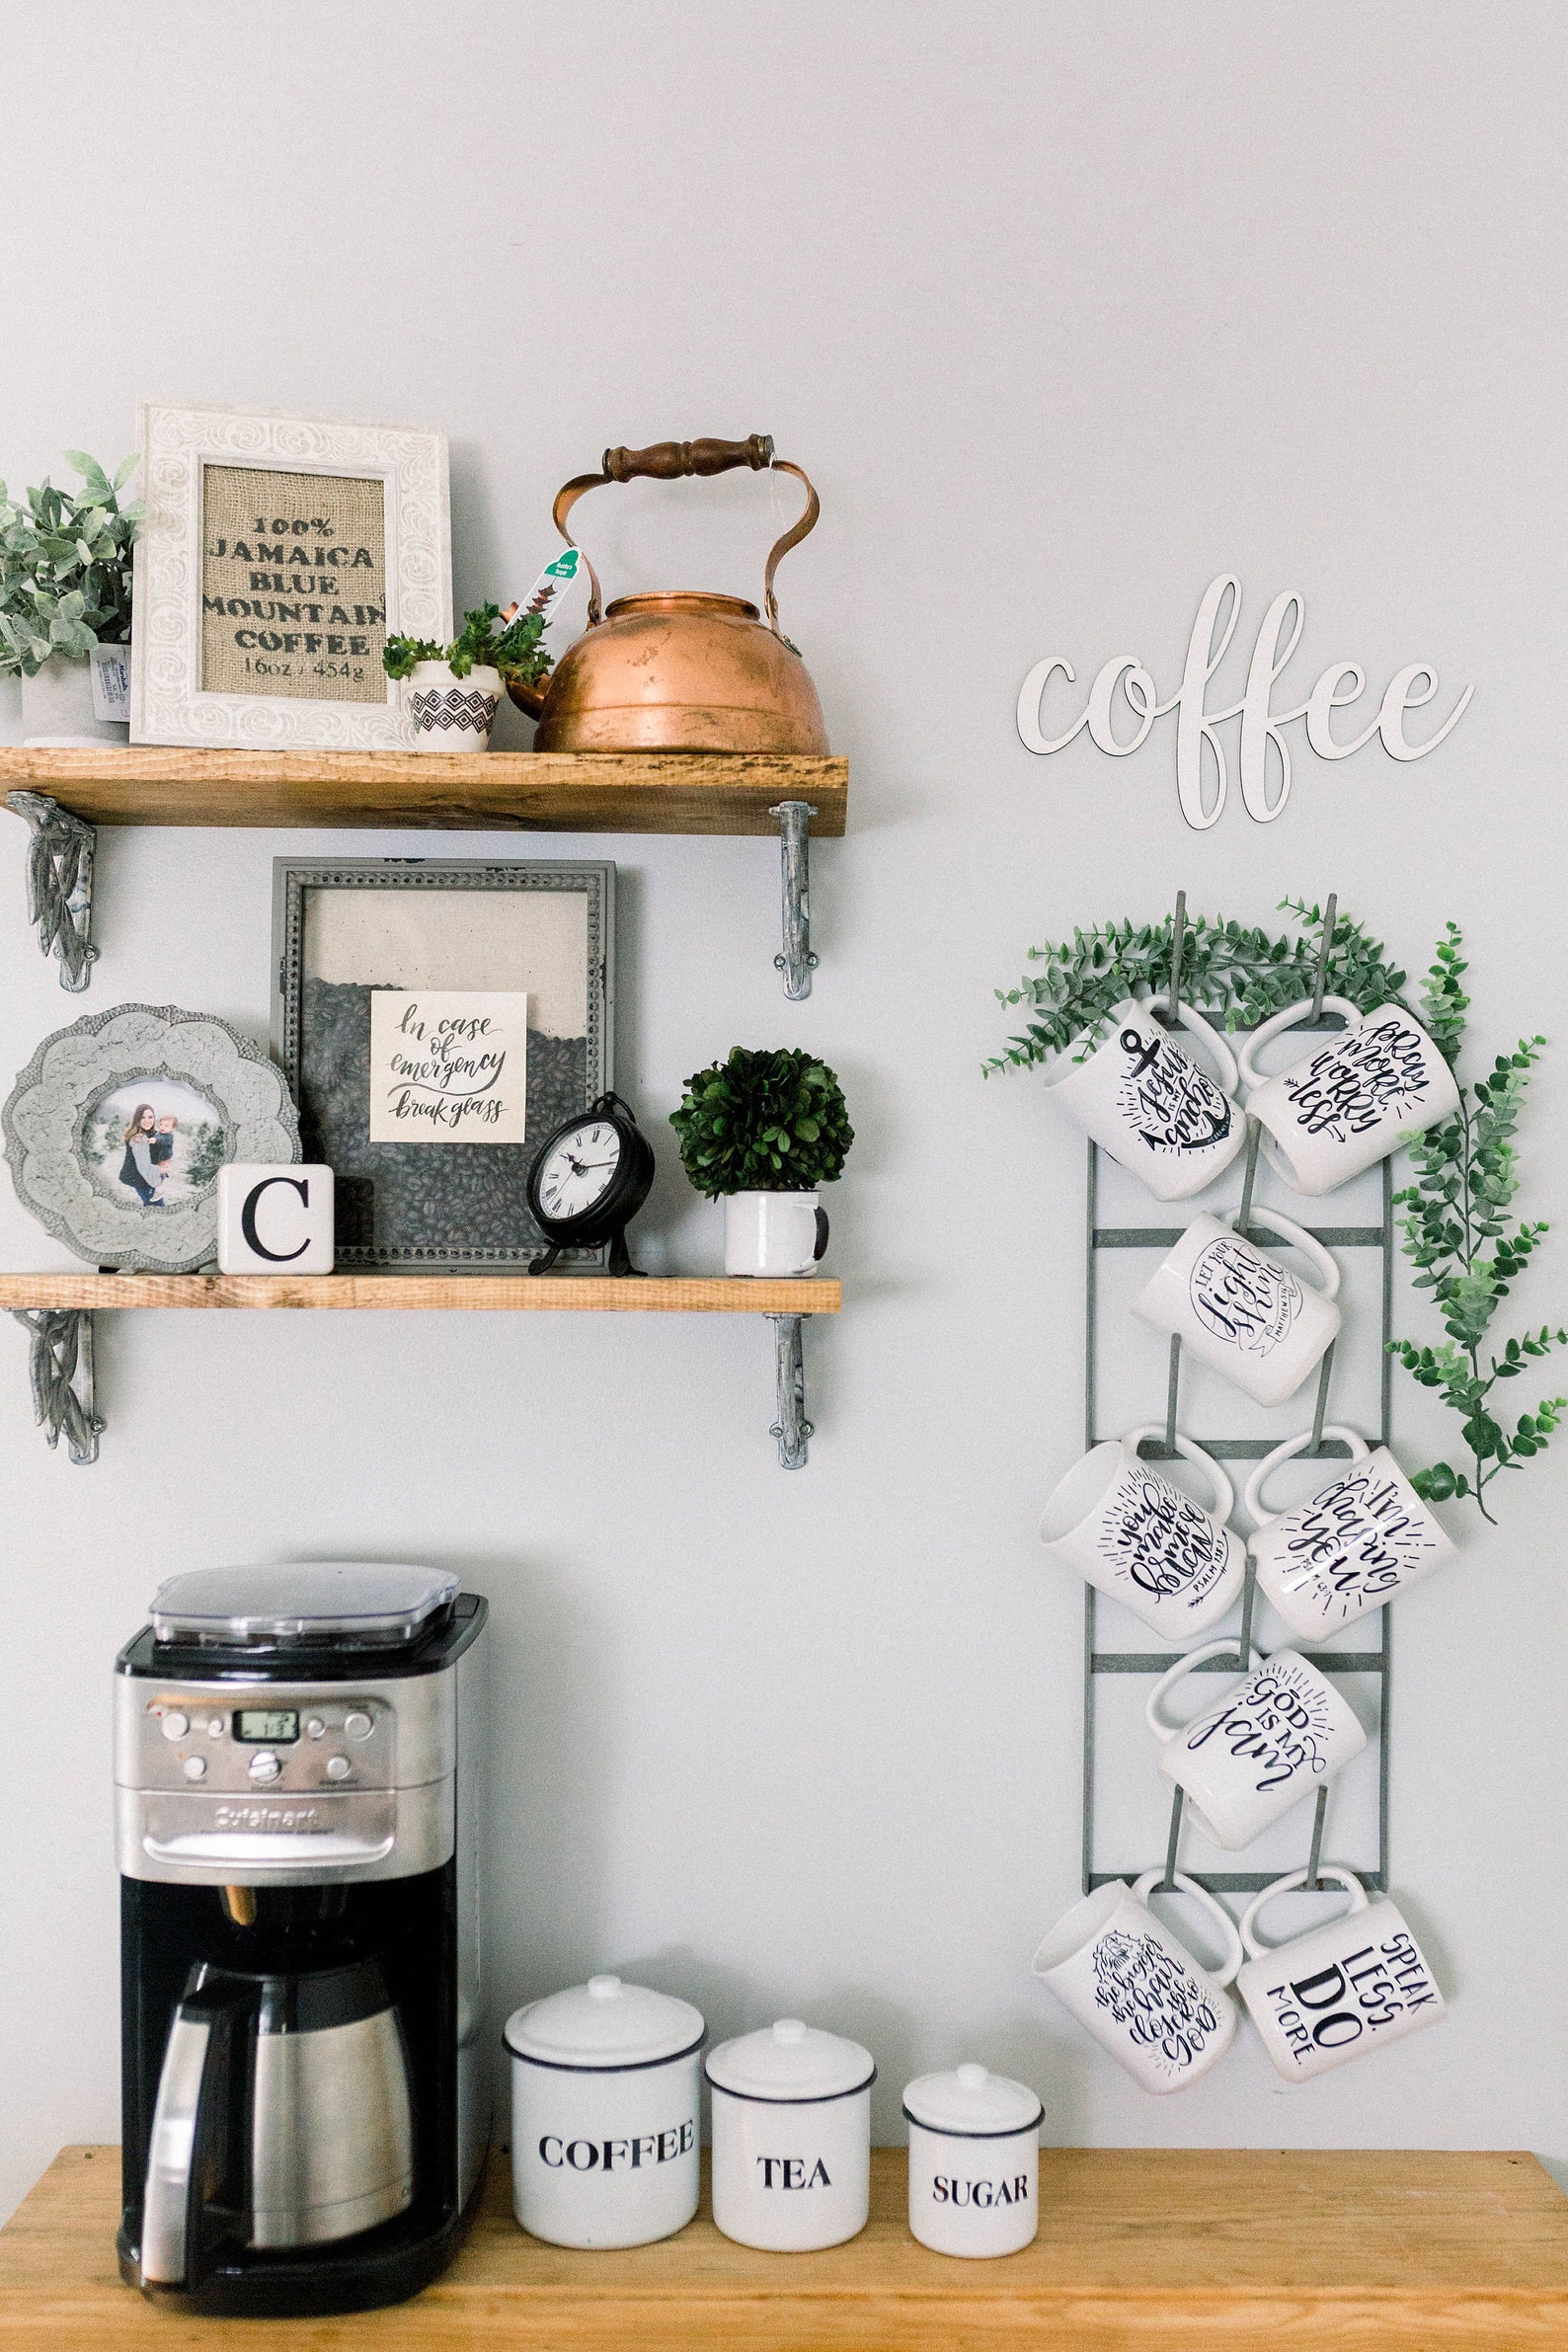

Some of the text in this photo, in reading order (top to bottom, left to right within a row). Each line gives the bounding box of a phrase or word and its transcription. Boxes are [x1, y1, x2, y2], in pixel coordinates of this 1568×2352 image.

[253, 517, 335, 536] 100%
[209, 539, 373, 568] JAMAICA
[250, 572, 340, 594] BLUE
[202, 594, 386, 625] MOUNTAIN
[234, 629, 369, 656] COFFEE
[246, 657, 291, 675] 16oz
[314, 661, 364, 682] 454g
[1016, 572, 1476, 830] coffee
[395, 1003, 504, 1041] In case
[430, 1033, 462, 1062] of
[386, 1051, 507, 1096] emergency
[1137, 1047, 1188, 1123] Jesus
[388, 1090, 510, 1128] break glass
[1167, 1089, 1182, 1112] IS MY
[1289, 1077, 1342, 1138] less
[241, 1177, 311, 1262] C
[1195, 1240, 1232, 1288] LET YOUR
[1232, 1264, 1288, 1350] shine
[1275, 1302, 1289, 1337] MATTHEW
[1117, 1503, 1153, 1546] you
[1133, 1483, 1177, 1561] make
[1364, 1481, 1409, 1537] I'm
[1164, 1521, 1190, 1559] me
[1288, 1513, 1361, 1597] you.
[1312, 1478, 1401, 1593] chasing
[1193, 1565, 1217, 1592] PSALM
[1246, 1678, 1309, 1729] GOD
[1187, 1701, 1294, 1791] jam
[1255, 1707, 1326, 1773] IS MY
[1094, 1933, 1163, 2008] the bigger
[1112, 1953, 1185, 2024] the hair
[1187, 1977, 1199, 2000] to
[1341, 1946, 1404, 2031] LESS.
[1380, 1933, 1438, 2014] SPEAK
[1166, 1979, 1186, 2013] the
[1290, 1963, 1363, 2048] DO
[1266, 1985, 1315, 2065] MORE.
[539, 2119, 694, 2171] COFFEE
[756, 2156, 831, 2190] TEA
[932, 2174, 1028, 2208] SUGAR
